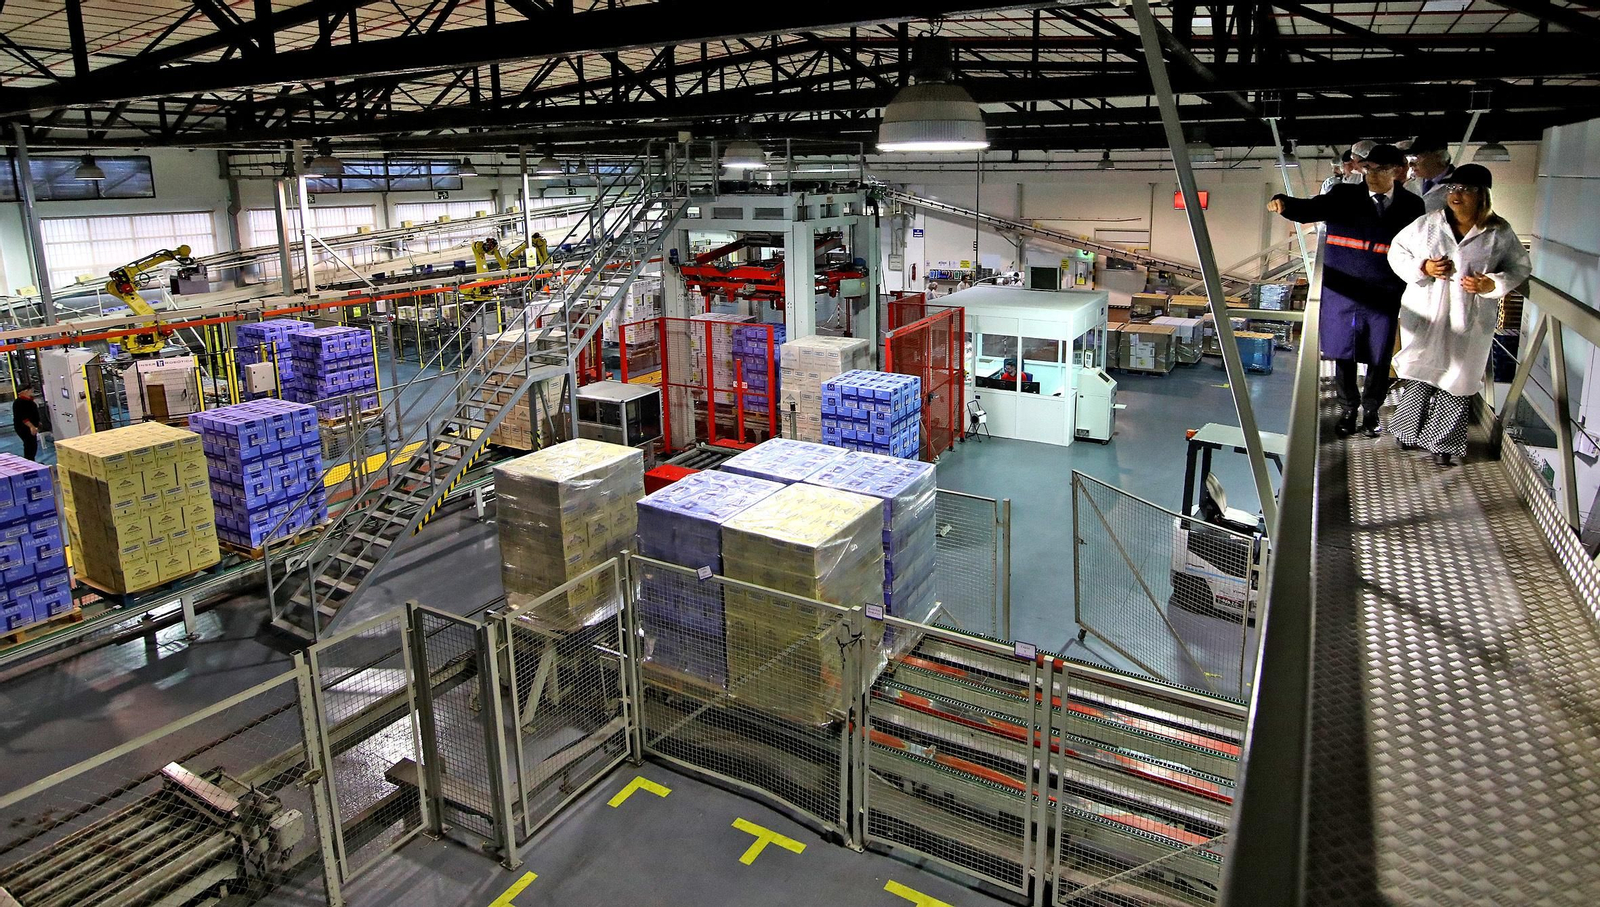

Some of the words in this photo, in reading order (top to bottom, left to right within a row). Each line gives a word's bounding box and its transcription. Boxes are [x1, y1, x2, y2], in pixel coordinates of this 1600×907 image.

[15, 475, 49, 488] HARVEYS
[25, 533, 58, 547] HARVEYS
[35, 590, 68, 603] HARVEYS
